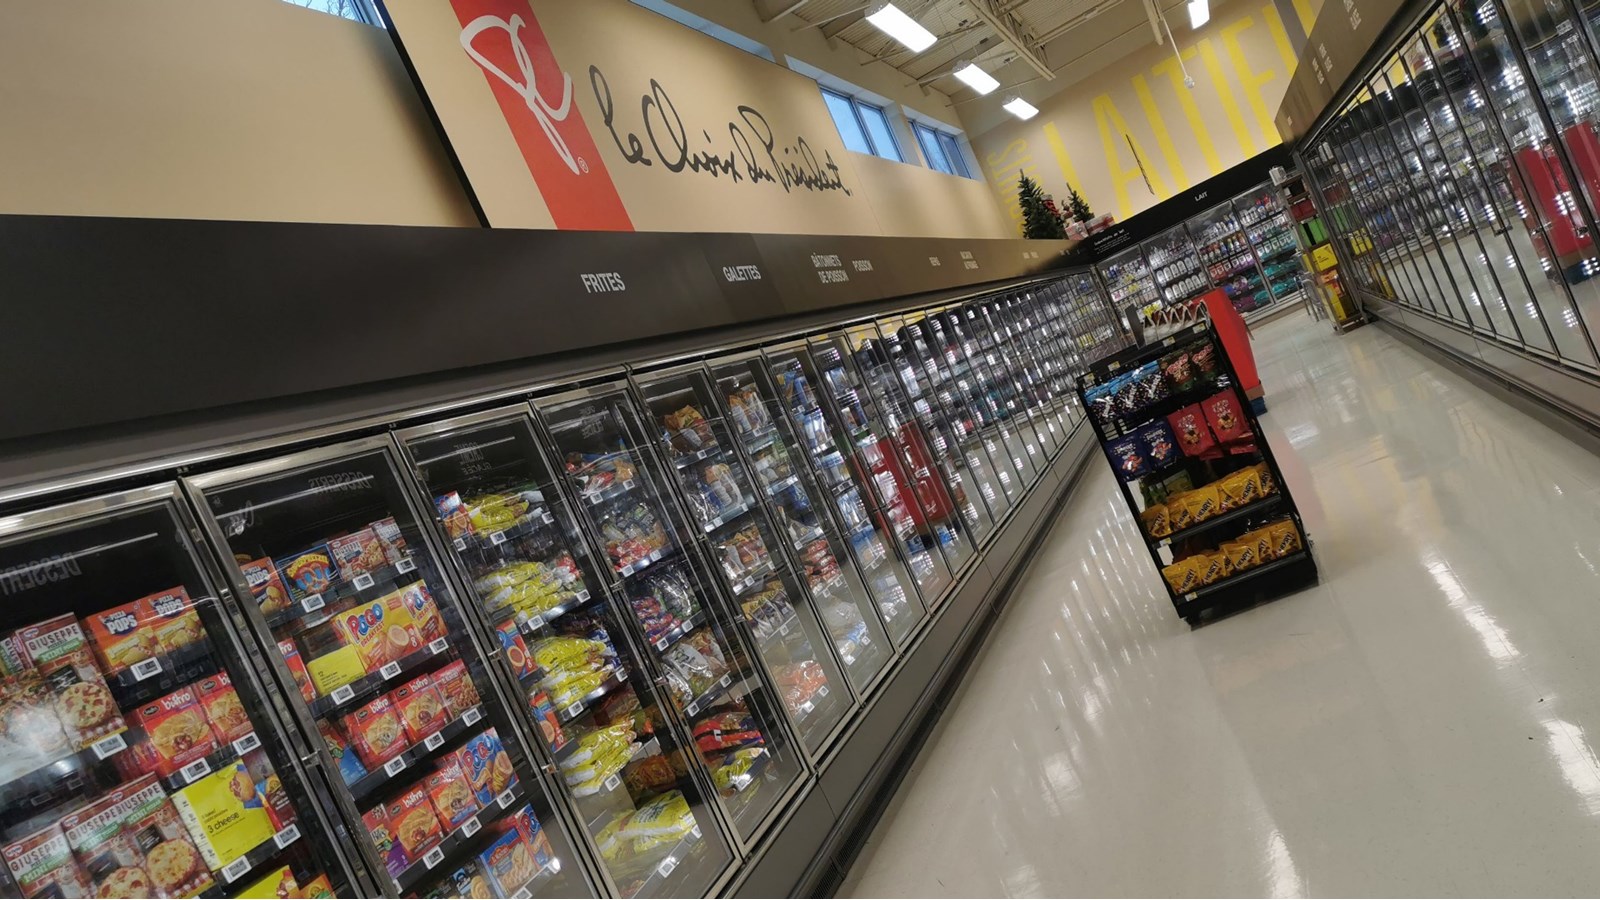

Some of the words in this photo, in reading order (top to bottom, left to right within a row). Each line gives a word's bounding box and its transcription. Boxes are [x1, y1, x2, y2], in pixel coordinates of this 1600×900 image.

[642, 78, 743, 183] Choix
[1194, 190, 1208, 202] LAIT
[722, 264, 762, 282] GALETTES
[825, 269, 850, 283] POISSON
[852, 259, 874, 272] POISSON
[580, 271, 626, 294] FRITES
[1197, 497, 1213, 518] HENRY!
[106, 614, 138, 635] POPS
[346, 603, 384, 645] POGO
[28, 625, 80, 651] GIUSEPPE
[69, 808, 118, 841] GIUSEPPE
[207, 824, 214, 834] 3
[214, 812, 240, 830] cheese
[10, 837, 65, 872] GIUSEPPE
